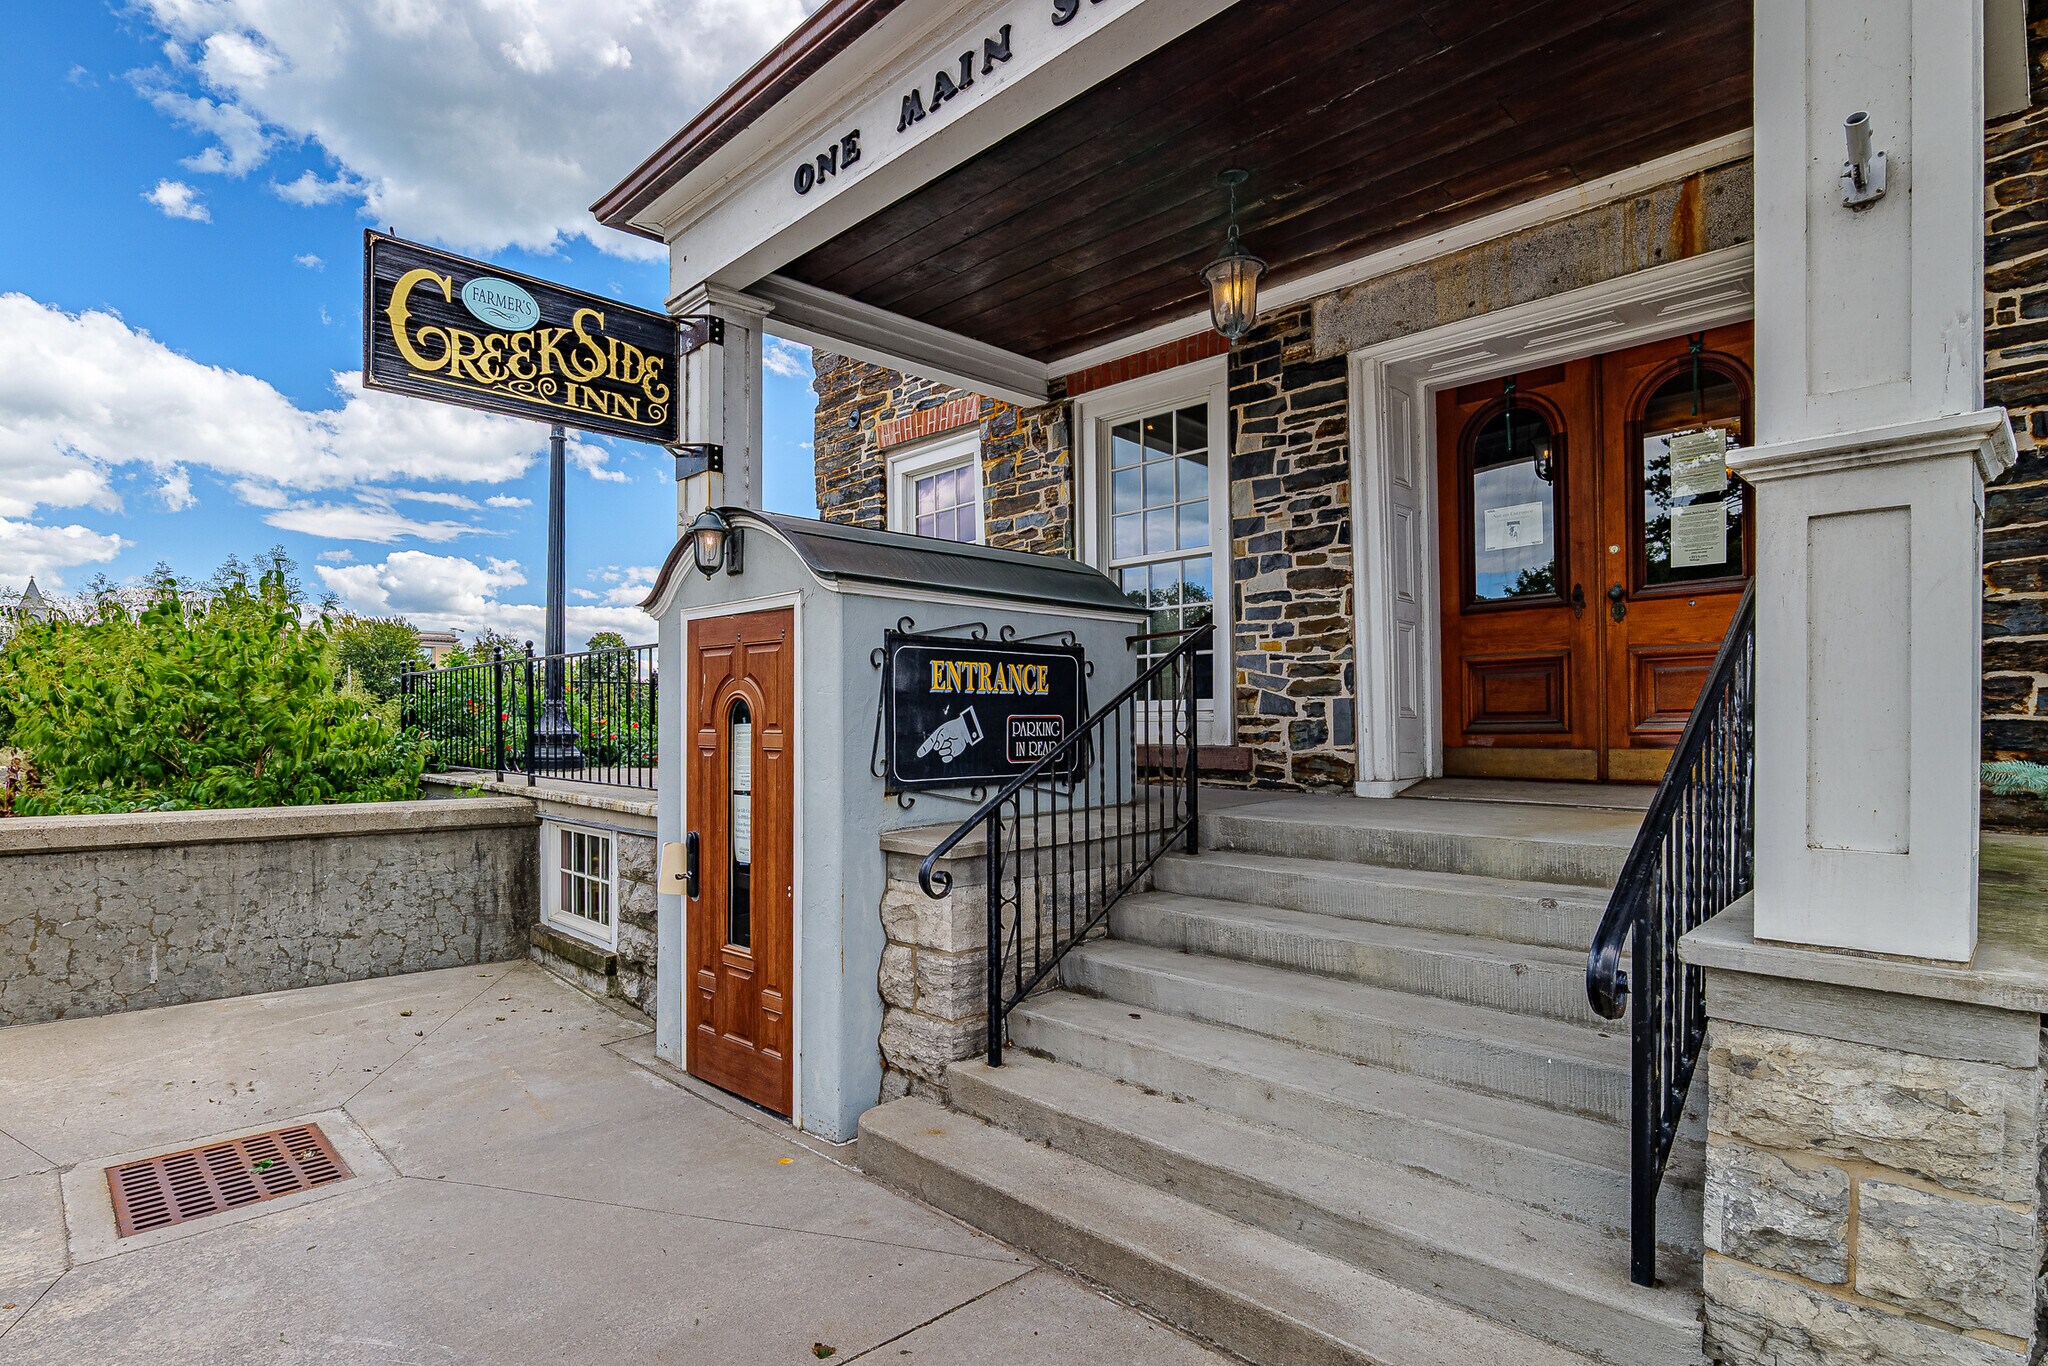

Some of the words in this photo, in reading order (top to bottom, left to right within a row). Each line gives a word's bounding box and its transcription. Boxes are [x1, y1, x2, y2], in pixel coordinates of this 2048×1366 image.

[793, 129, 861, 195] ONE
[896, 23, 1012, 133] MAIN
[472, 286, 532, 316] FARMER'S
[564, 381, 641, 421] INN
[929, 659, 1050, 696] ENTRANCE
[1011, 721, 1060, 737] PARKING
[1015, 741, 1026, 757] IN
